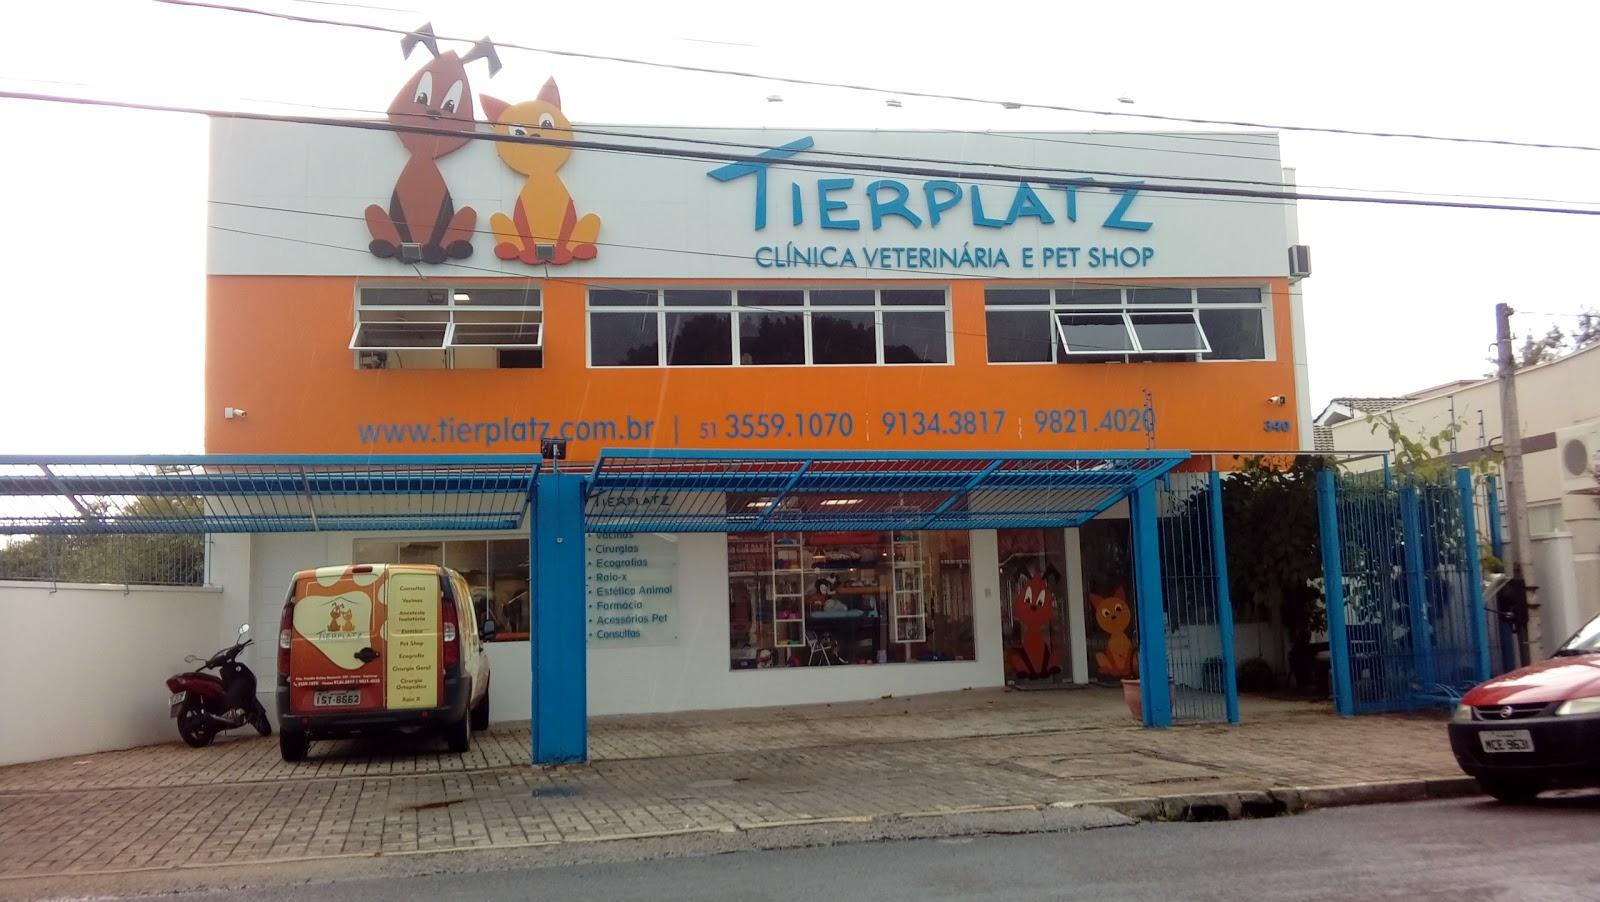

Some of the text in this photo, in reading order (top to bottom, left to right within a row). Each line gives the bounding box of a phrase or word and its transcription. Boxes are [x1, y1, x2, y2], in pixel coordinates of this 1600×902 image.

[706, 135, 1154, 231] TIERPLATZ
[755, 241, 1155, 269] CLÍNICA VETERINÁRIA E PET SHOP
[358, 416, 655, 447] www.tierplatz.com.br
[724, 411, 853, 439] 3559.1070
[881, 410, 1006, 436] 9134.3817
[1033, 407, 1155, 434] 9821.4020
[1263, 420, 1290, 432] 340
[596, 544, 639, 555] Cirurgias
[596, 559, 648, 569] Ecografias
[596, 584, 673, 597] Estética Animal
[597, 600, 643, 611] Farmácia
[597, 613, 668, 625] Acessórios Pet
[597, 628, 641, 639] Consultas
